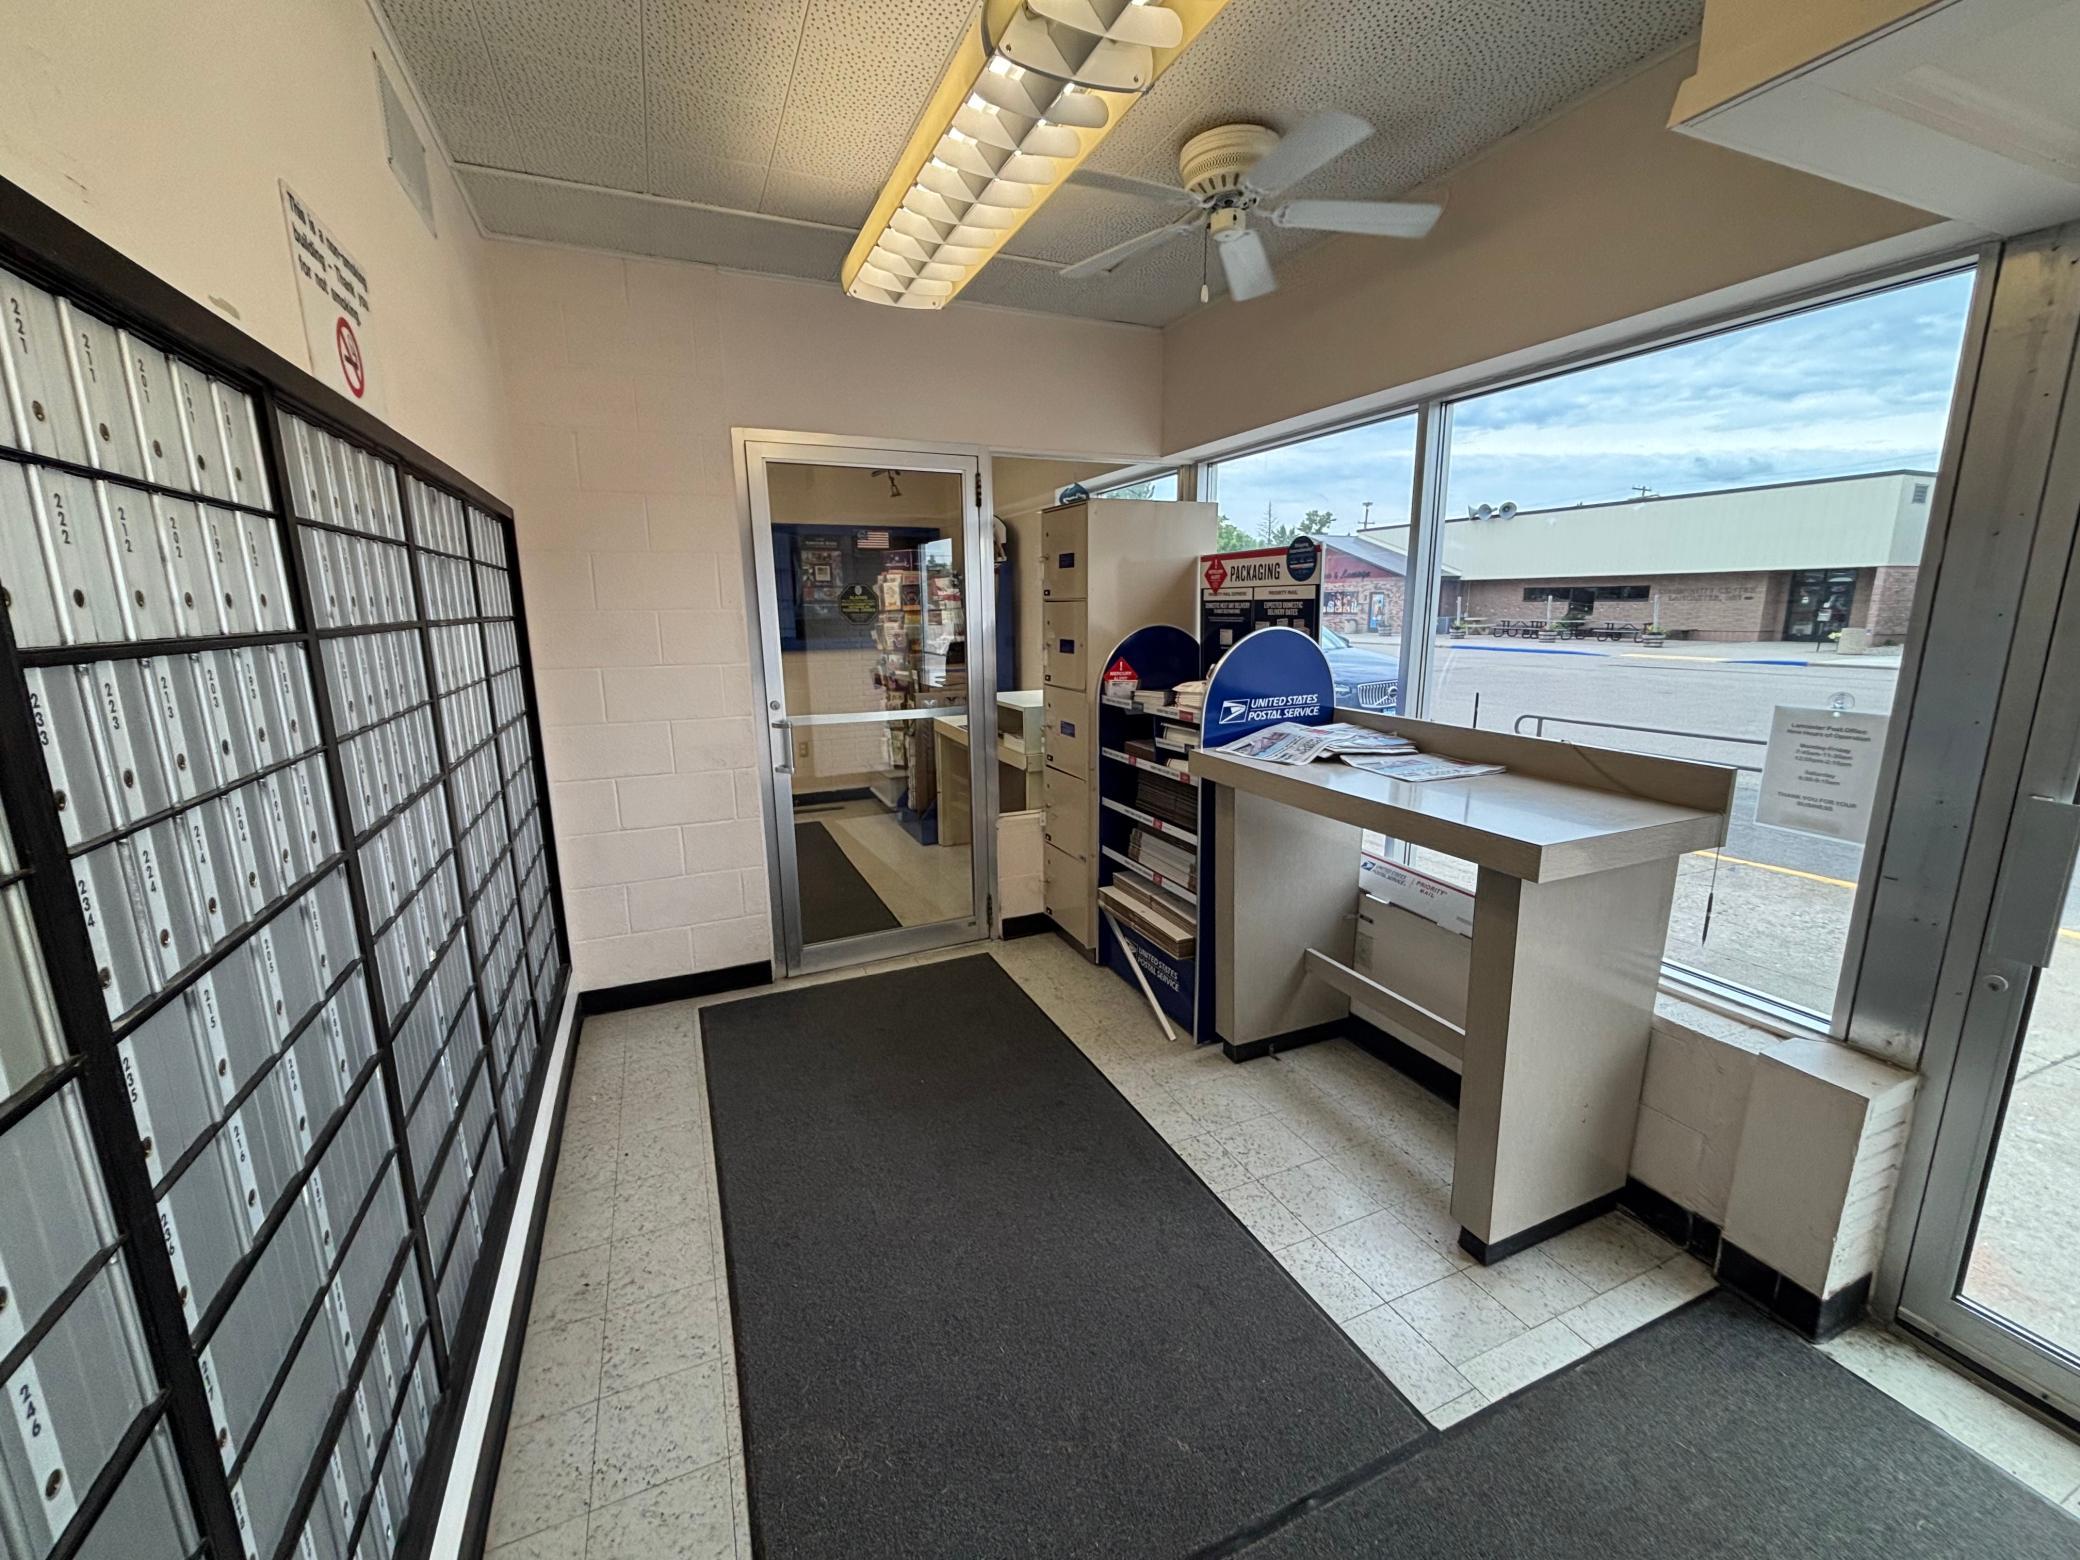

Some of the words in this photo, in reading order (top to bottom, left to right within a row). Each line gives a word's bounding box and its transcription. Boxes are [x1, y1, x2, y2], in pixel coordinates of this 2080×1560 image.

[286, 190, 306, 225] This
[307, 212, 316, 235] is
[318, 228, 324, 244] a
[298, 253, 312, 279] for
[314, 272, 329, 295] not
[334, 264, 356, 298] Thank
[357, 291, 370, 312] you
[10, 297, 28, 354] 221
[81, 333, 96, 383] 211
[137, 358, 150, 403] 201
[53, 492, 70, 544] 222
[117, 506, 133, 553] 212
[169, 516, 183, 558] 202
[1230, 562, 1281, 583] PACKAGING
[31, 692, 49, 746] 233
[105, 683, 120, 730] 223
[161, 676, 174, 719] 213
[1248, 709, 1282, 721] POSTAL
[1283, 705, 1320, 718] SERVICE
[1250, 696, 1285, 709] UNITED
[1286, 693, 1318, 706] STATES
[194, 826, 206, 864] 214
[235, 806, 248, 843] 204
[142, 850, 156, 893] 224
[77, 879, 95, 928] 234
[1137, 956, 1156, 976] POSTAL
[1156, 970, 1180, 992] SERVICE
[1138, 946, 1159, 966] UNITED
[1158, 961, 1179, 980] STATES
[203, 988, 216, 1029] 215
[122, 1056, 138, 1103] 235
[233, 1125, 246, 1163] 216
[160, 1213, 175, 1257] 236
[19, 1383, 42, 1438] 246
